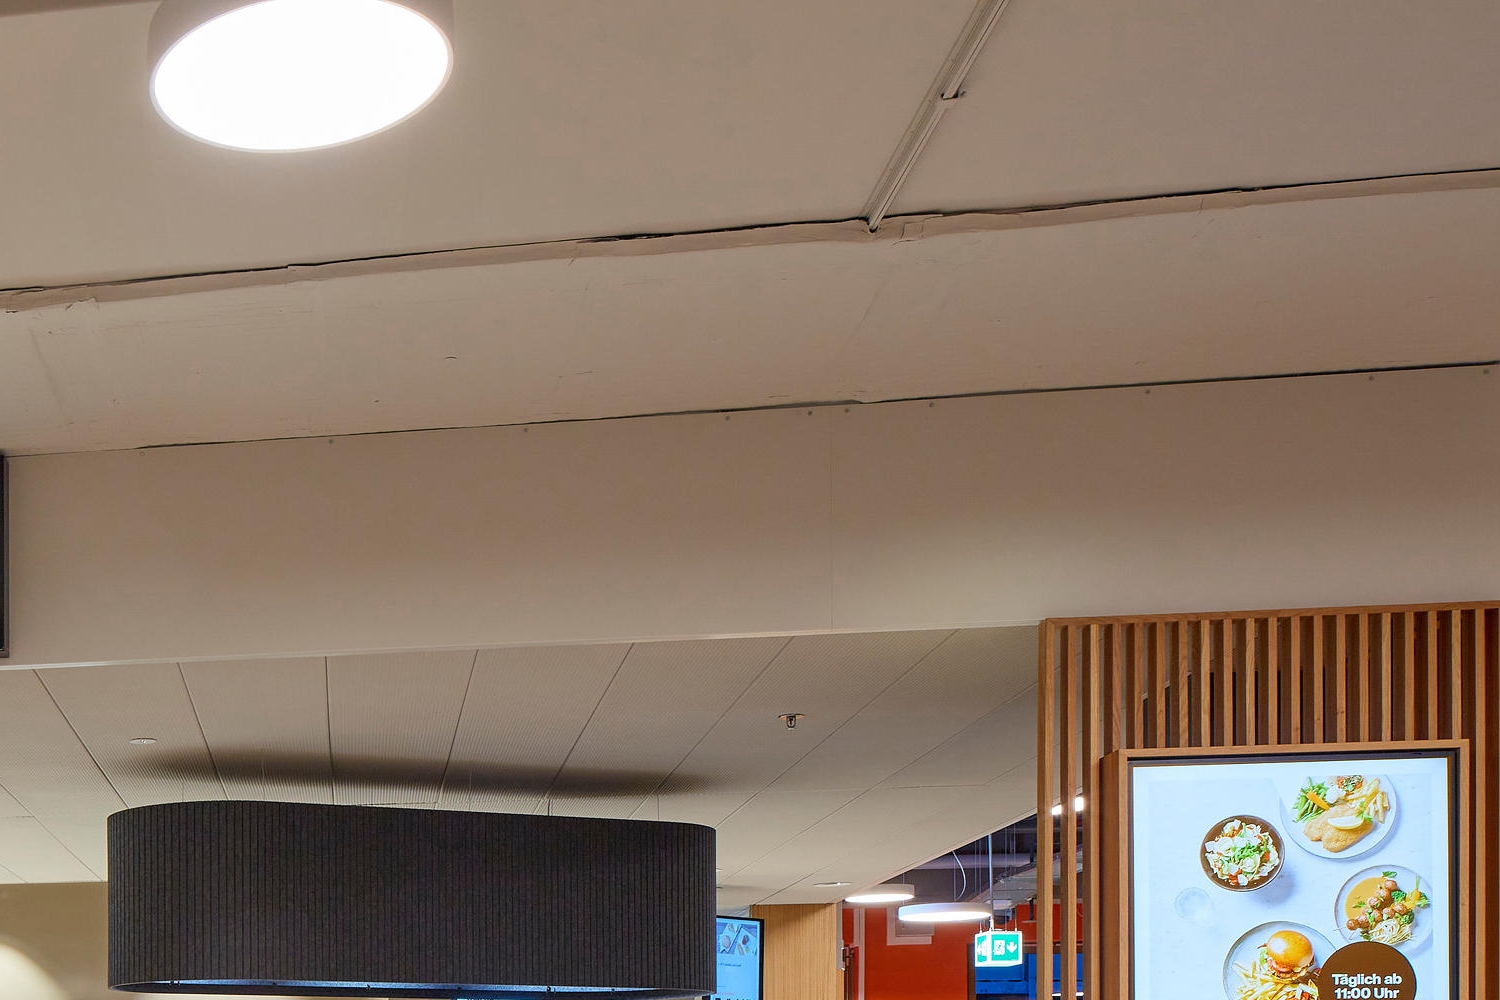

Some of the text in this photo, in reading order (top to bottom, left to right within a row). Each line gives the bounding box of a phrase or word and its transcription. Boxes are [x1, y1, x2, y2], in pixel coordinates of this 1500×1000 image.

[1332, 973, 1402, 988] Täglich ab
[1334, 988, 1400, 1000] 11:00 Uhr
